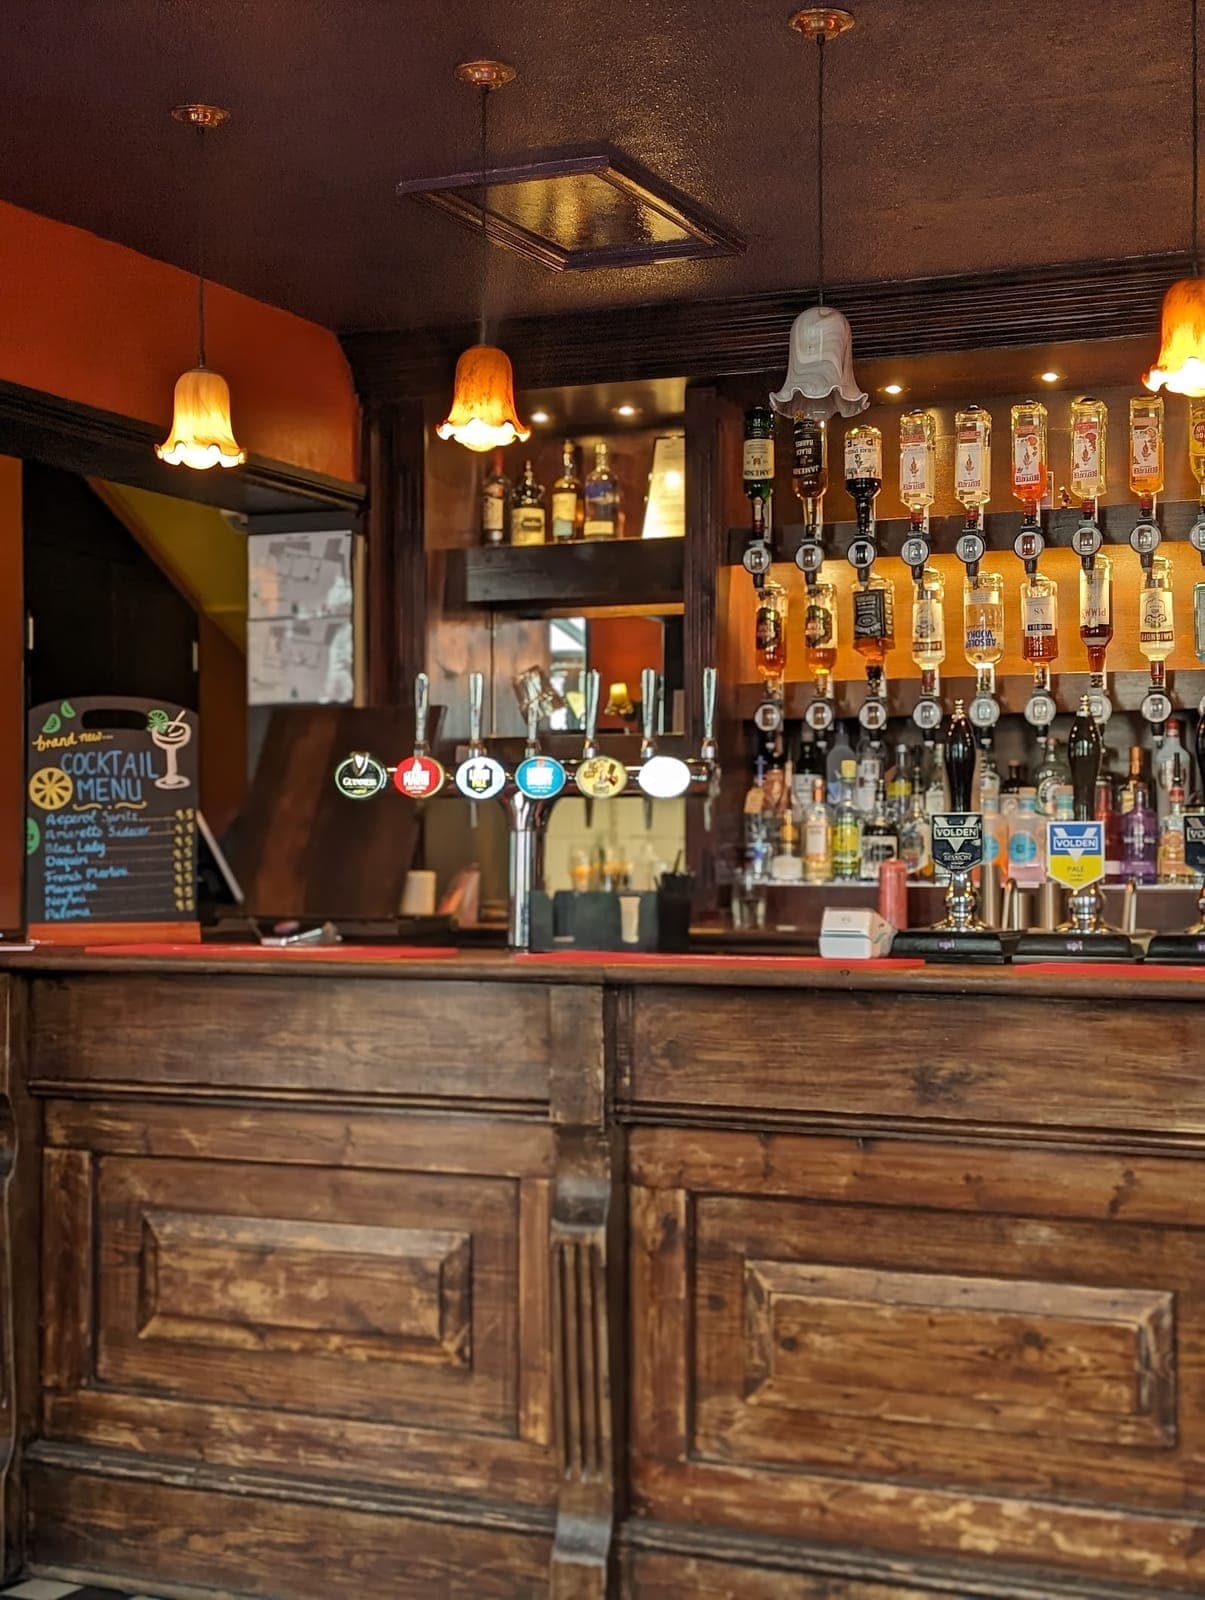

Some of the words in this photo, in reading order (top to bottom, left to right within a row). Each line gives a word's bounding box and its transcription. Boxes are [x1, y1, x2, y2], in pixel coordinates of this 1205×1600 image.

[1074, 469, 1097, 479] BEEFEATER
[1134, 467, 1159, 475] BEEFEATER
[1016, 474, 1039, 483] BEEFEATER
[32, 732, 78, 751] brand
[61, 750, 160, 779] COCKTAIL
[76, 776, 142, 802] MENU
[936, 828, 977, 837] VOLDEN
[1055, 838, 1097, 848] VOLDEN
[77, 841, 107, 858] Lady
